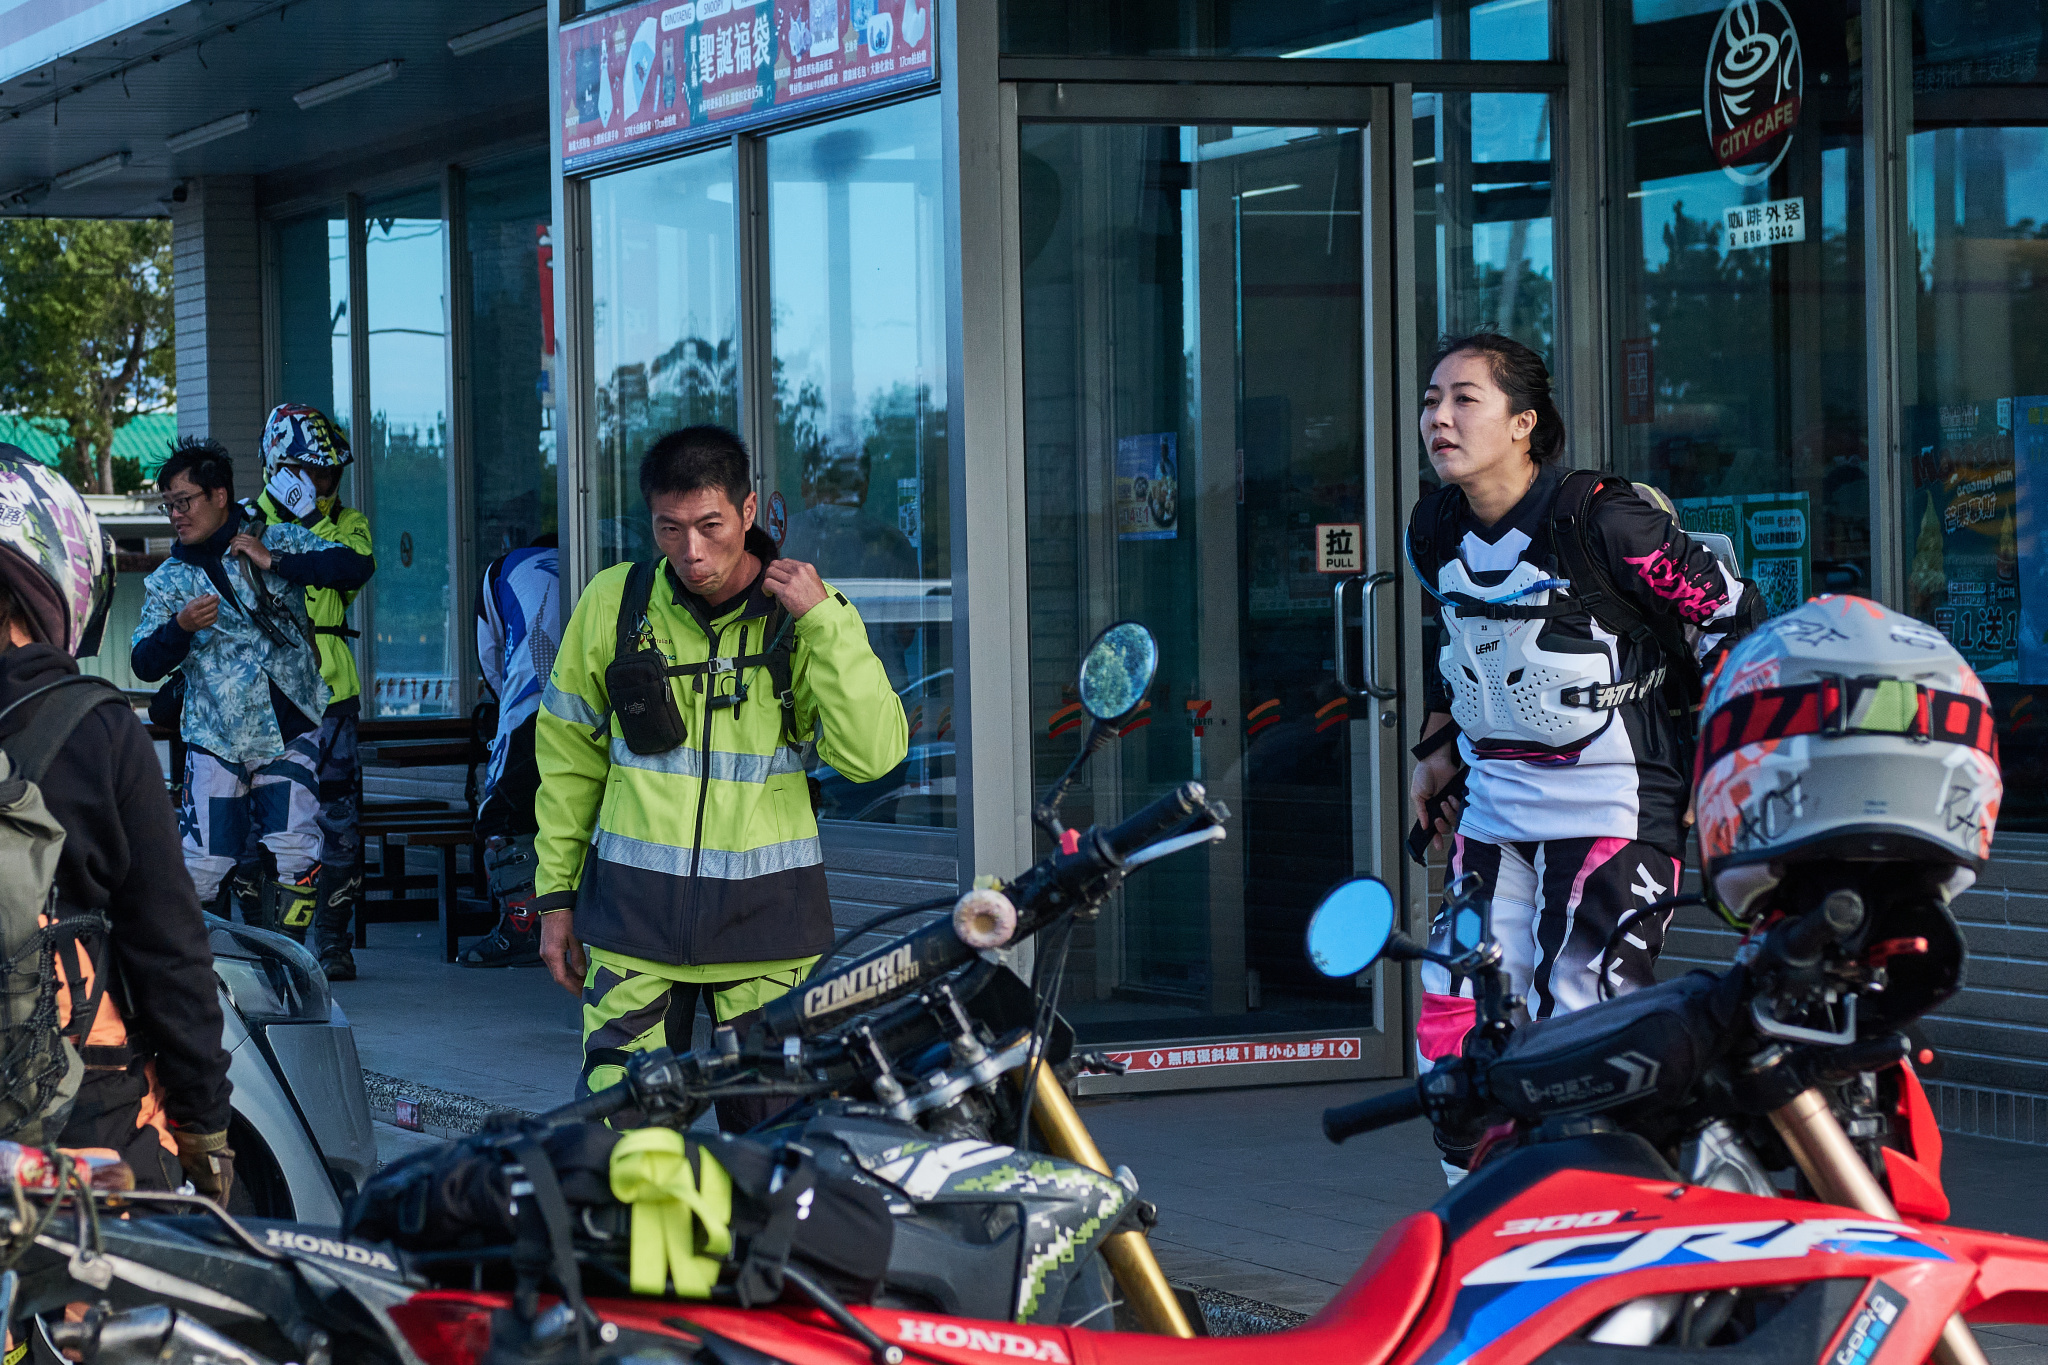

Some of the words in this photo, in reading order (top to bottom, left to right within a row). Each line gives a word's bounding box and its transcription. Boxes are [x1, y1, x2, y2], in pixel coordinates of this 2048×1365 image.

[698, 12, 771, 84] 聖誕福袋
[1719, 124, 1752, 160] CITY
[1753, 102, 1793, 140] CAFE
[1727, 202, 1801, 229] 咖啡外送
[297, 452, 325, 467] Airoh
[1325, 529, 1354, 556] 拉
[1326, 557, 1354, 568] PULL
[1475, 639, 1500, 655] LEATT
[1596, 682, 1634, 708] EATT
[803, 943, 913, 1020] CONTROL
[1493, 1208, 1663, 1237] 300L
[265, 1229, 398, 1272] HONDA
[1461, 1219, 1921, 1286] CRF
[898, 1318, 1069, 1365] HONDA
